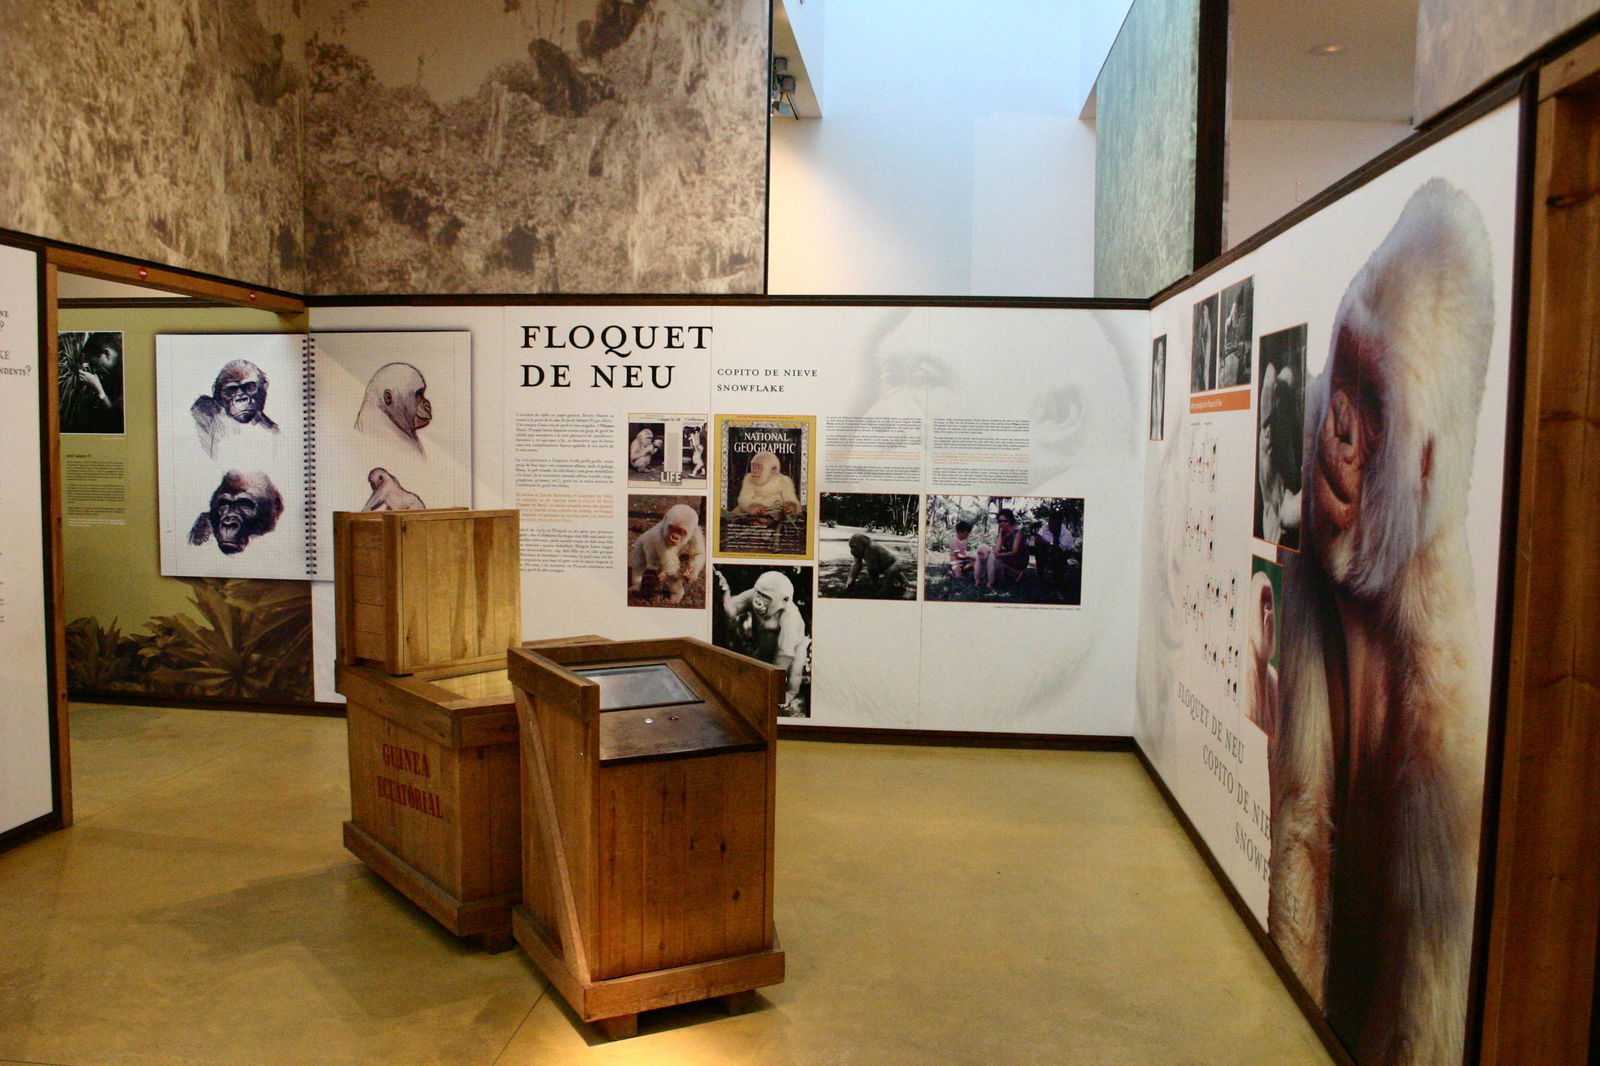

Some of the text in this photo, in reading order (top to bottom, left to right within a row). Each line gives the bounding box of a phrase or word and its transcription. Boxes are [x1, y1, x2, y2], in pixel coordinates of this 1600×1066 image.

[519, 324, 714, 359] FLOQUET
[520, 364, 677, 389] DE NEU
[717, 368, 819, 378] COPITO DE NIEVE
[716, 384, 786, 393] SNOWFLAKE
[744, 432, 790, 442] NATIONAL
[733, 442, 797, 455] GEOGRAPHIC
[660, 471, 682, 483] LIFE
[1178, 681, 1246, 764] FLOQUET DE NEU
[382, 743, 430, 778] GUINEA
[1202, 744, 1234, 795] COPITO
[1236, 782, 1249, 815] DE
